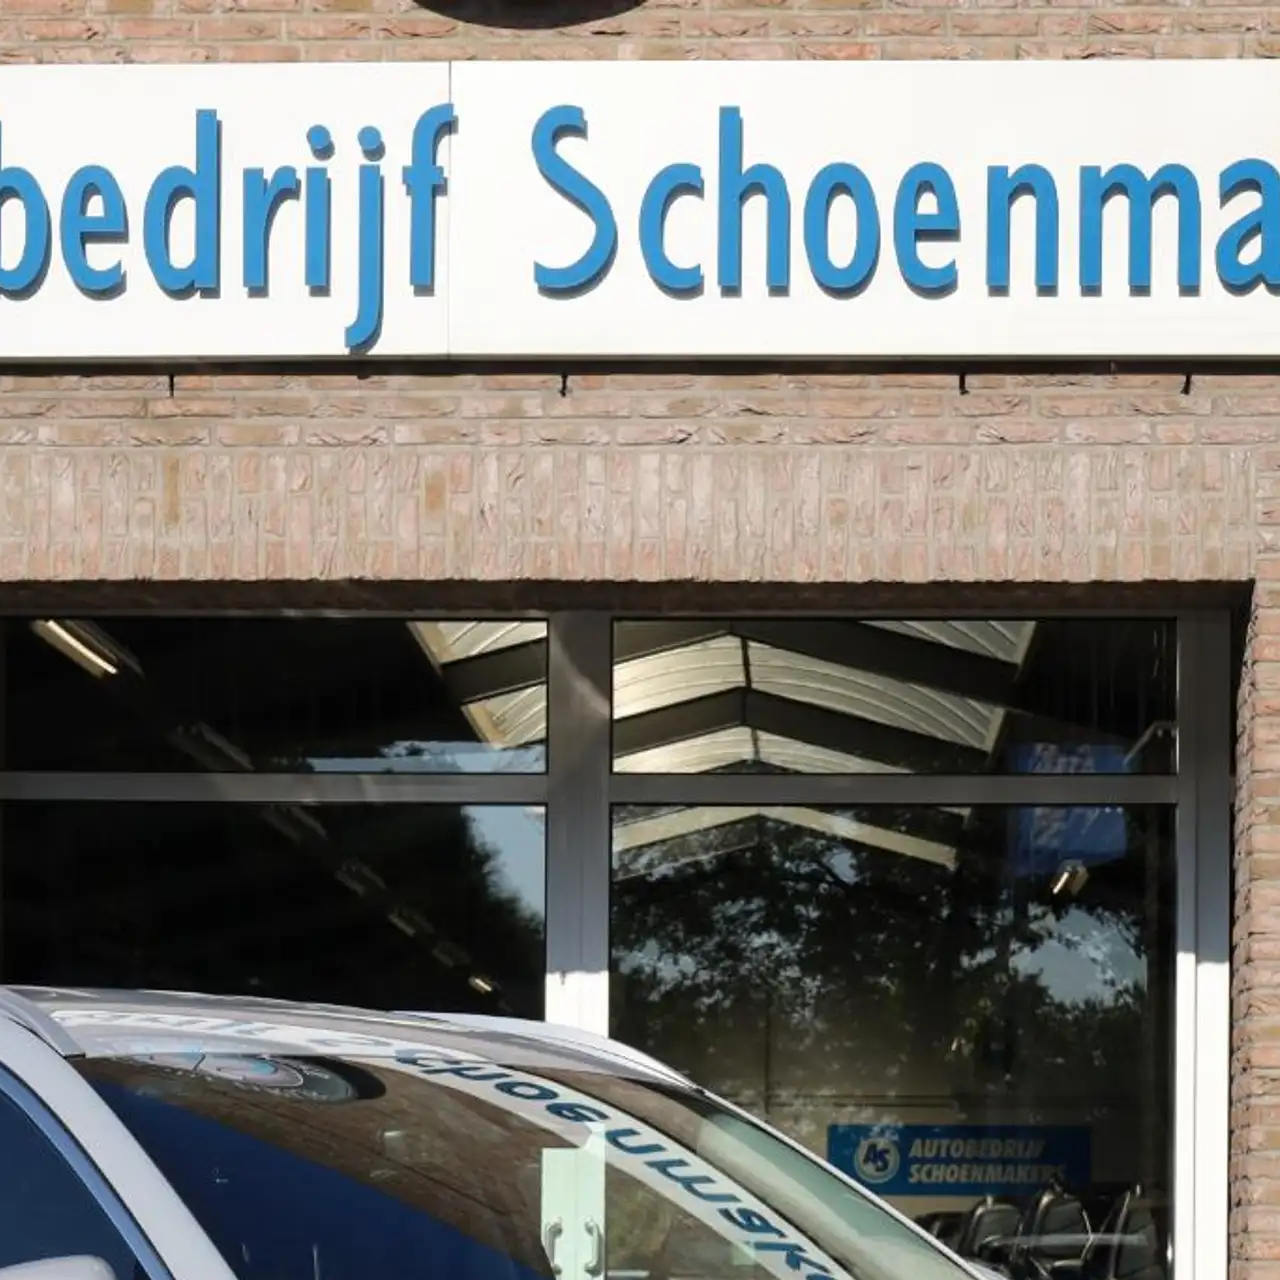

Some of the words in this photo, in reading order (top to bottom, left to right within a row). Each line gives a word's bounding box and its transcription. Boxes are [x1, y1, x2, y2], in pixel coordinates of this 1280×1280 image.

[862, 1143, 891, 1173] AS
[908, 1137, 1046, 1159] AUTOBEDRIJF
[907, 1163, 1067, 1184] SCHOENMAKERS
